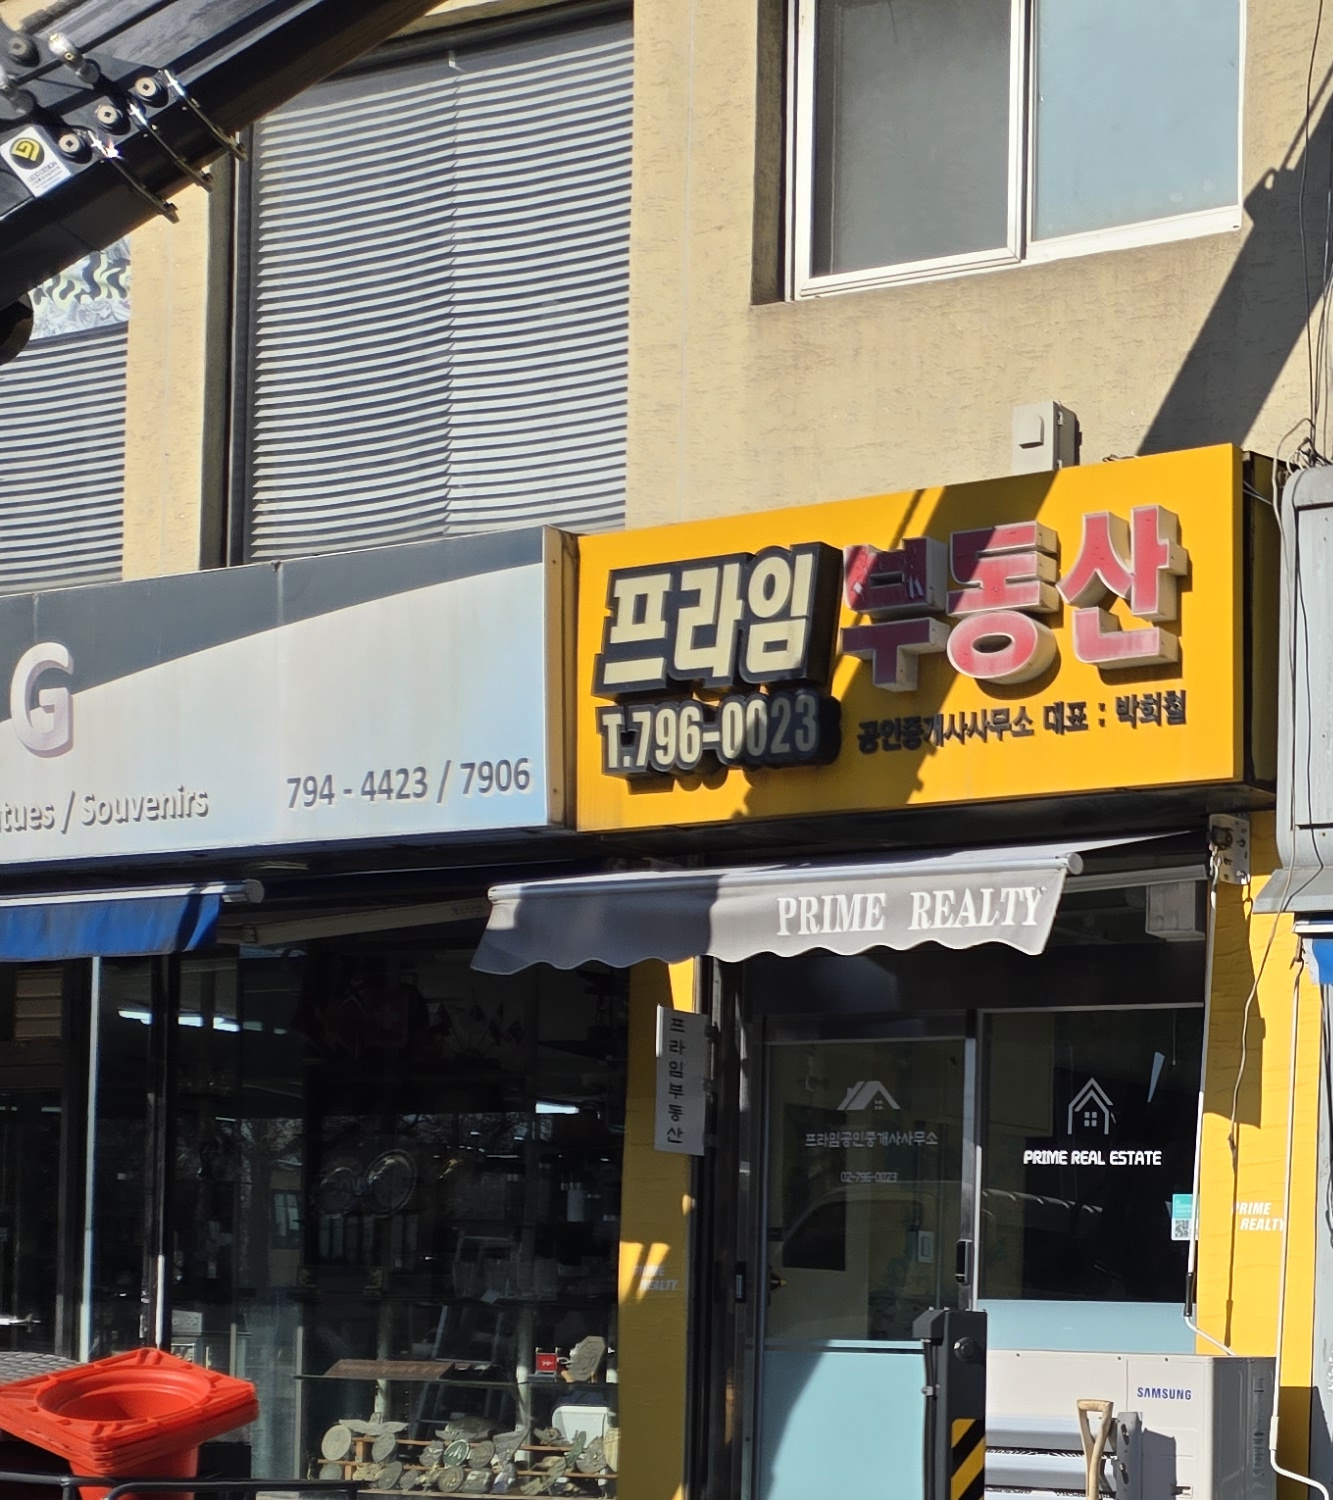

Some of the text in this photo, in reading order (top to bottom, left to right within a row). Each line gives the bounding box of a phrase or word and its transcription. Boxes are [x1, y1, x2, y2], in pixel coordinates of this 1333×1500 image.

[603, 504, 1180, 692] 프라임 부동산
[602, 695, 819, 769] T.796-0023
[857, 706, 1034, 755] 공인중개사사무소
[1044, 701, 1088, 735] 대표
[0, 801, 55, 832] tues
[81, 784, 209, 826] Souvenirs
[286, 776, 335, 810] 794
[360, 765, 428, 802] 4423
[459, 756, 531, 796] 7906
[777, 886, 1047, 937] PRIME REALTY
[667, 1018, 686, 1143] 프라임부동산
[1023, 1150, 1162, 1166] PRIME REAL ESTATE
[1240, 1218, 1285, 1231] REALTY
[1137, 1387, 1192, 1400] SAMSUNG
